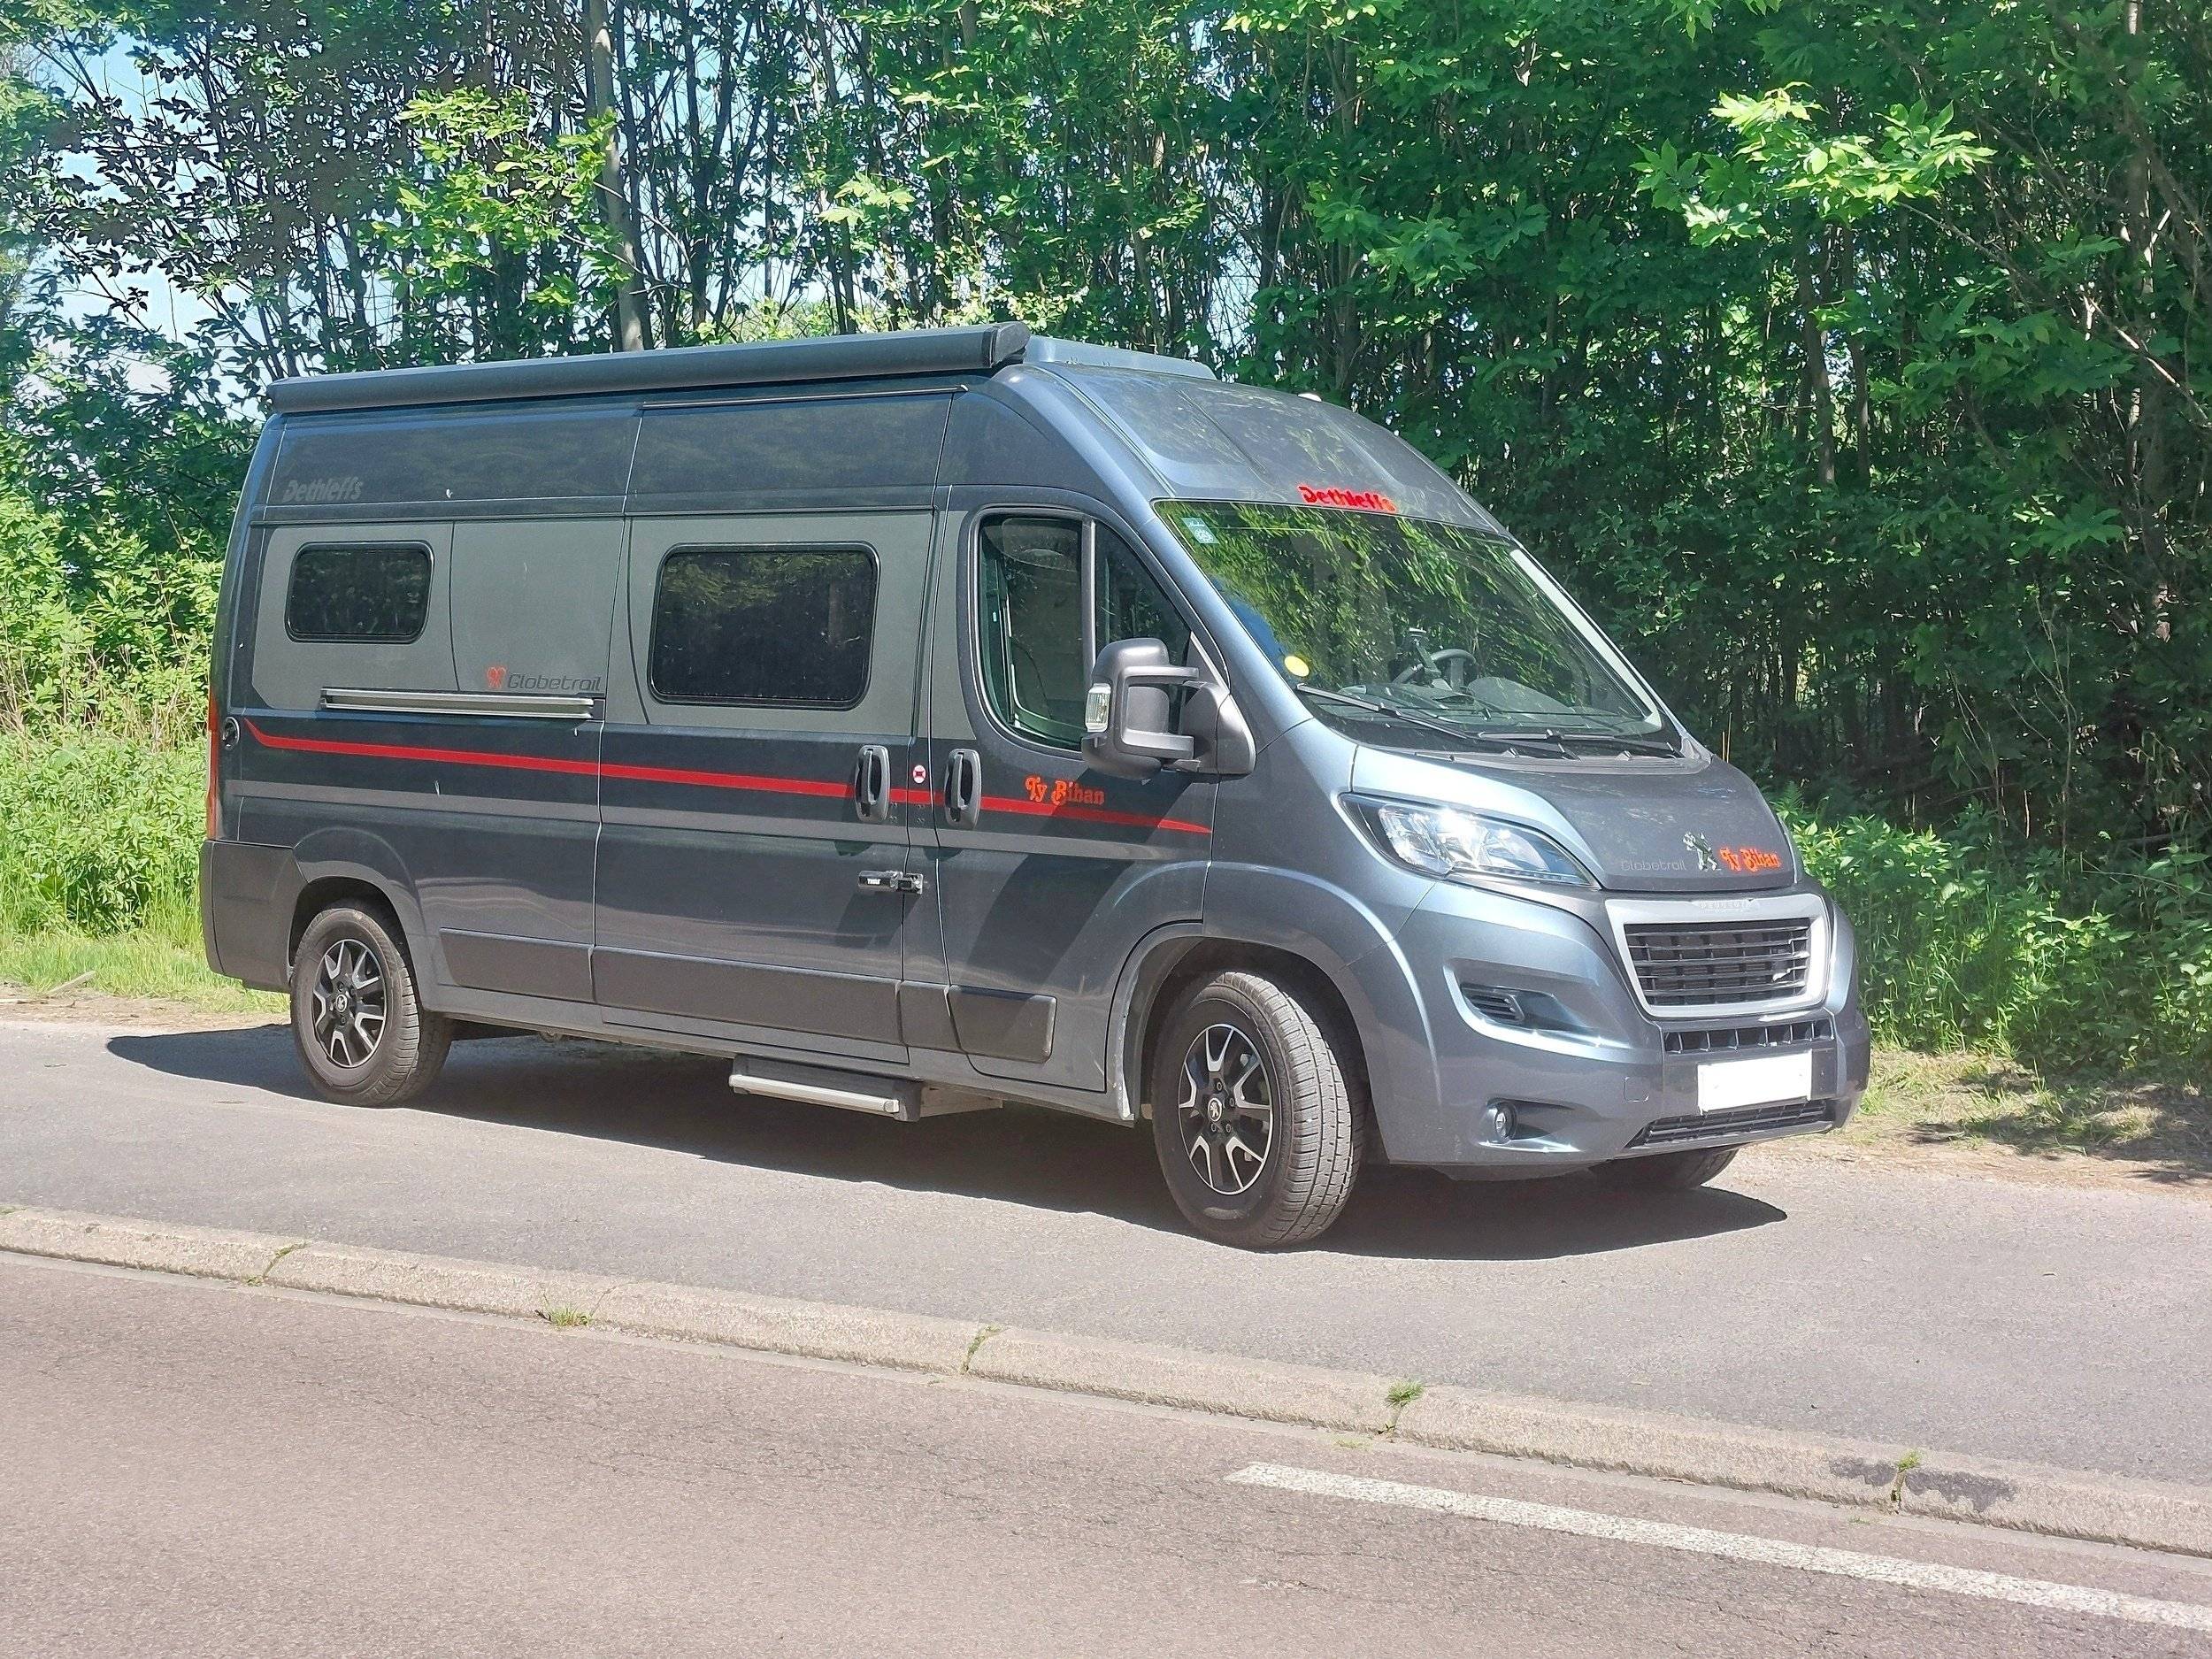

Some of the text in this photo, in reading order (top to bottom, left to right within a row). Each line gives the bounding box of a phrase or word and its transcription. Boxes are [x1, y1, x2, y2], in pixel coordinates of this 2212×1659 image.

[282, 476, 364, 503] Dethleffs
[507, 672, 602, 691] Globetrail
[1025, 776, 1048, 803] Ty
[1620, 858, 1687, 872] Globetrail
[1719, 847, 1741, 872] Ty
